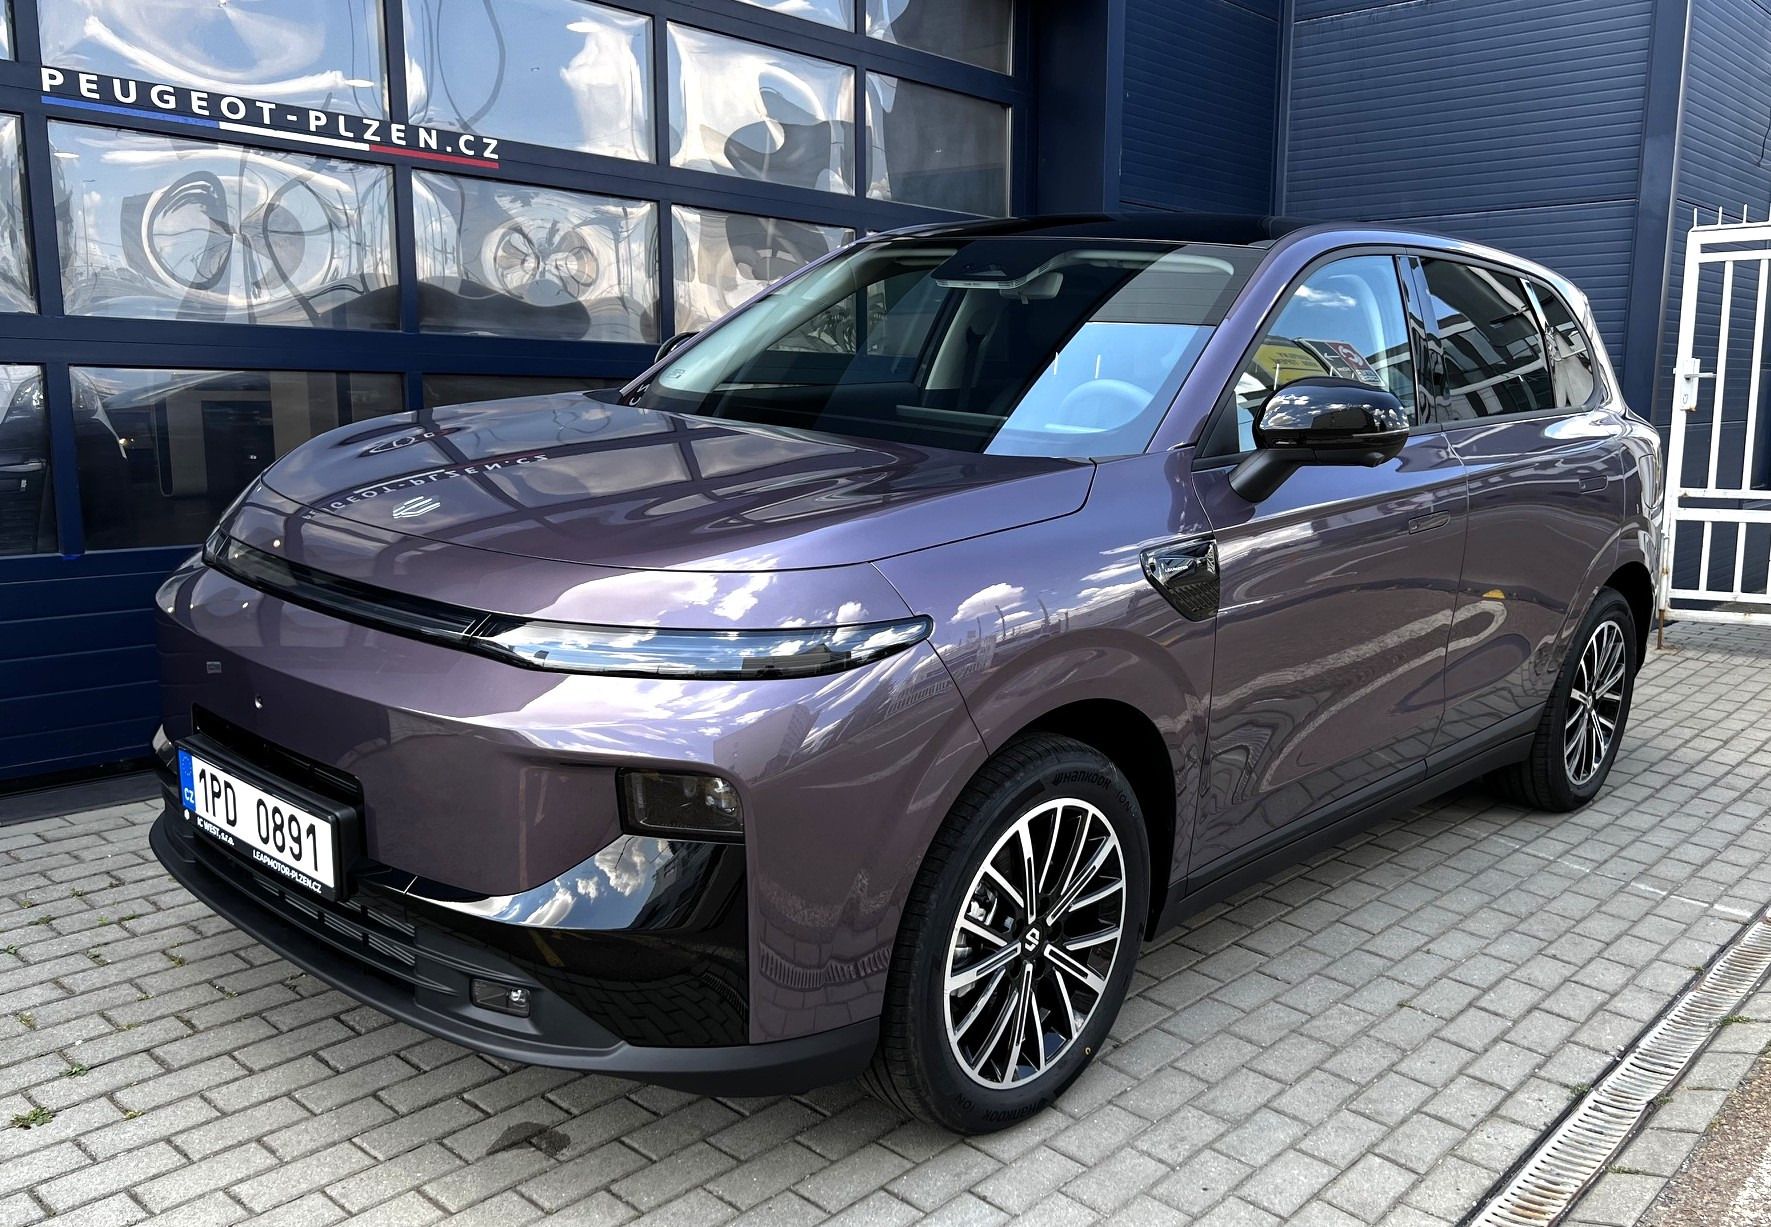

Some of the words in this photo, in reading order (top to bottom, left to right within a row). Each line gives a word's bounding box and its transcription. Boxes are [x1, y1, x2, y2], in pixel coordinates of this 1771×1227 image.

[41, 66, 500, 160] PEUGEOT-PLZEN.CZ
[184, 787, 195, 803] CZ
[199, 768, 237, 828] 1PD
[256, 798, 319, 872] 0891
[253, 849, 323, 894] LEAPMOTOR-PLZEN.CZ
